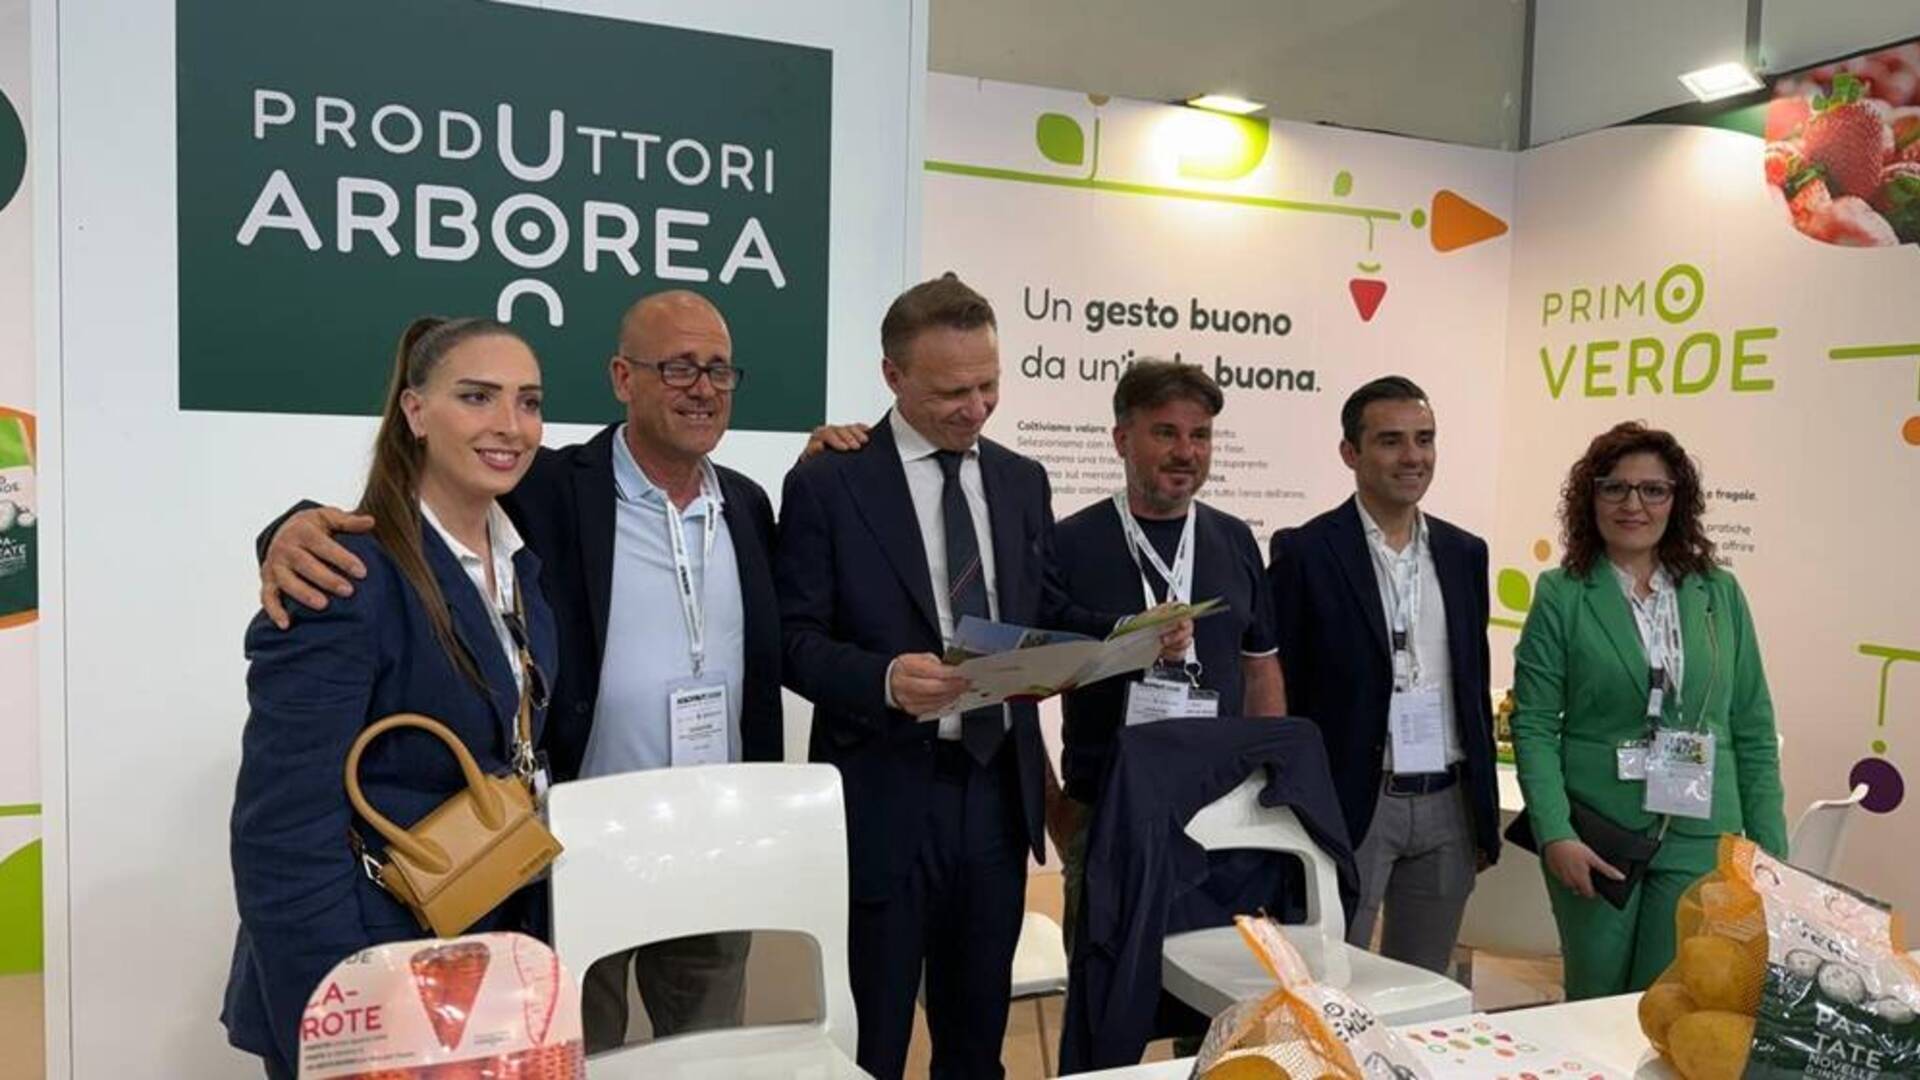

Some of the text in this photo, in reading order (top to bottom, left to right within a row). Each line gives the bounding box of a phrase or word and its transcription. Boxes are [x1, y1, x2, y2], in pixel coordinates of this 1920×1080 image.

[254, 89, 775, 193] PRODUTTORI
[237, 169, 786, 289] ARBOREA
[1024, 287, 1292, 336] Un gesto buono
[1541, 264, 1705, 327] PRIMO
[1021, 345, 1065, 379] da
[1215, 356, 1321, 392] buona.
[1540, 328, 1778, 400] VERDE
[303, 1005, 382, 1041] ROTE
[1813, 1031, 1884, 1070] TATE
